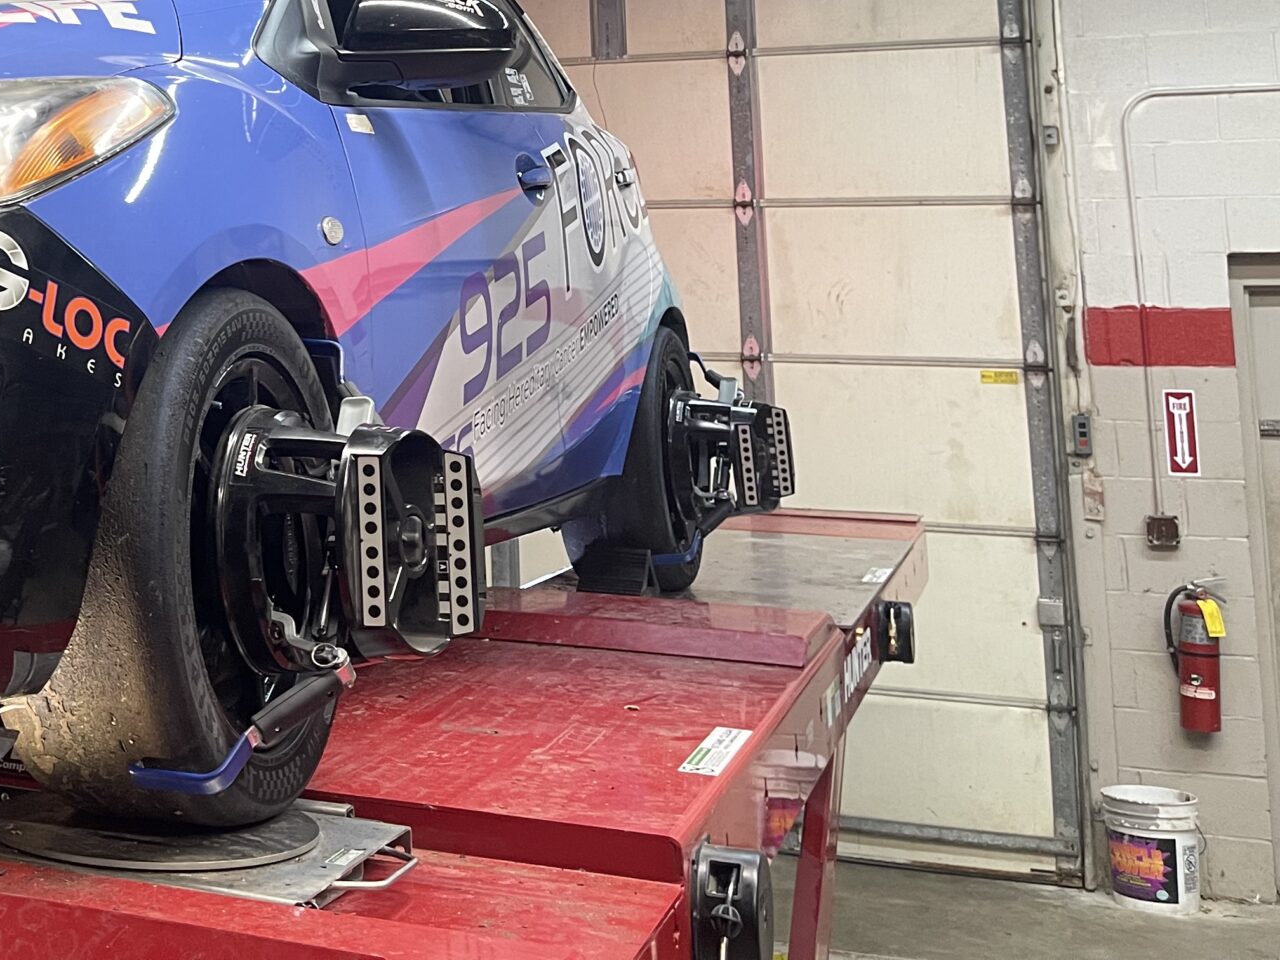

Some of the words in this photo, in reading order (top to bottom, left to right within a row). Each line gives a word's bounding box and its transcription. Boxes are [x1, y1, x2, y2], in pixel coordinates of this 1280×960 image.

[460, 231, 551, 406] 925
[473, 397, 505, 441] Facing
[578, 293, 619, 351] EMPOWERED
[1172, 402, 1187, 411] FIRE
[234, 433, 253, 477] HUNTER
